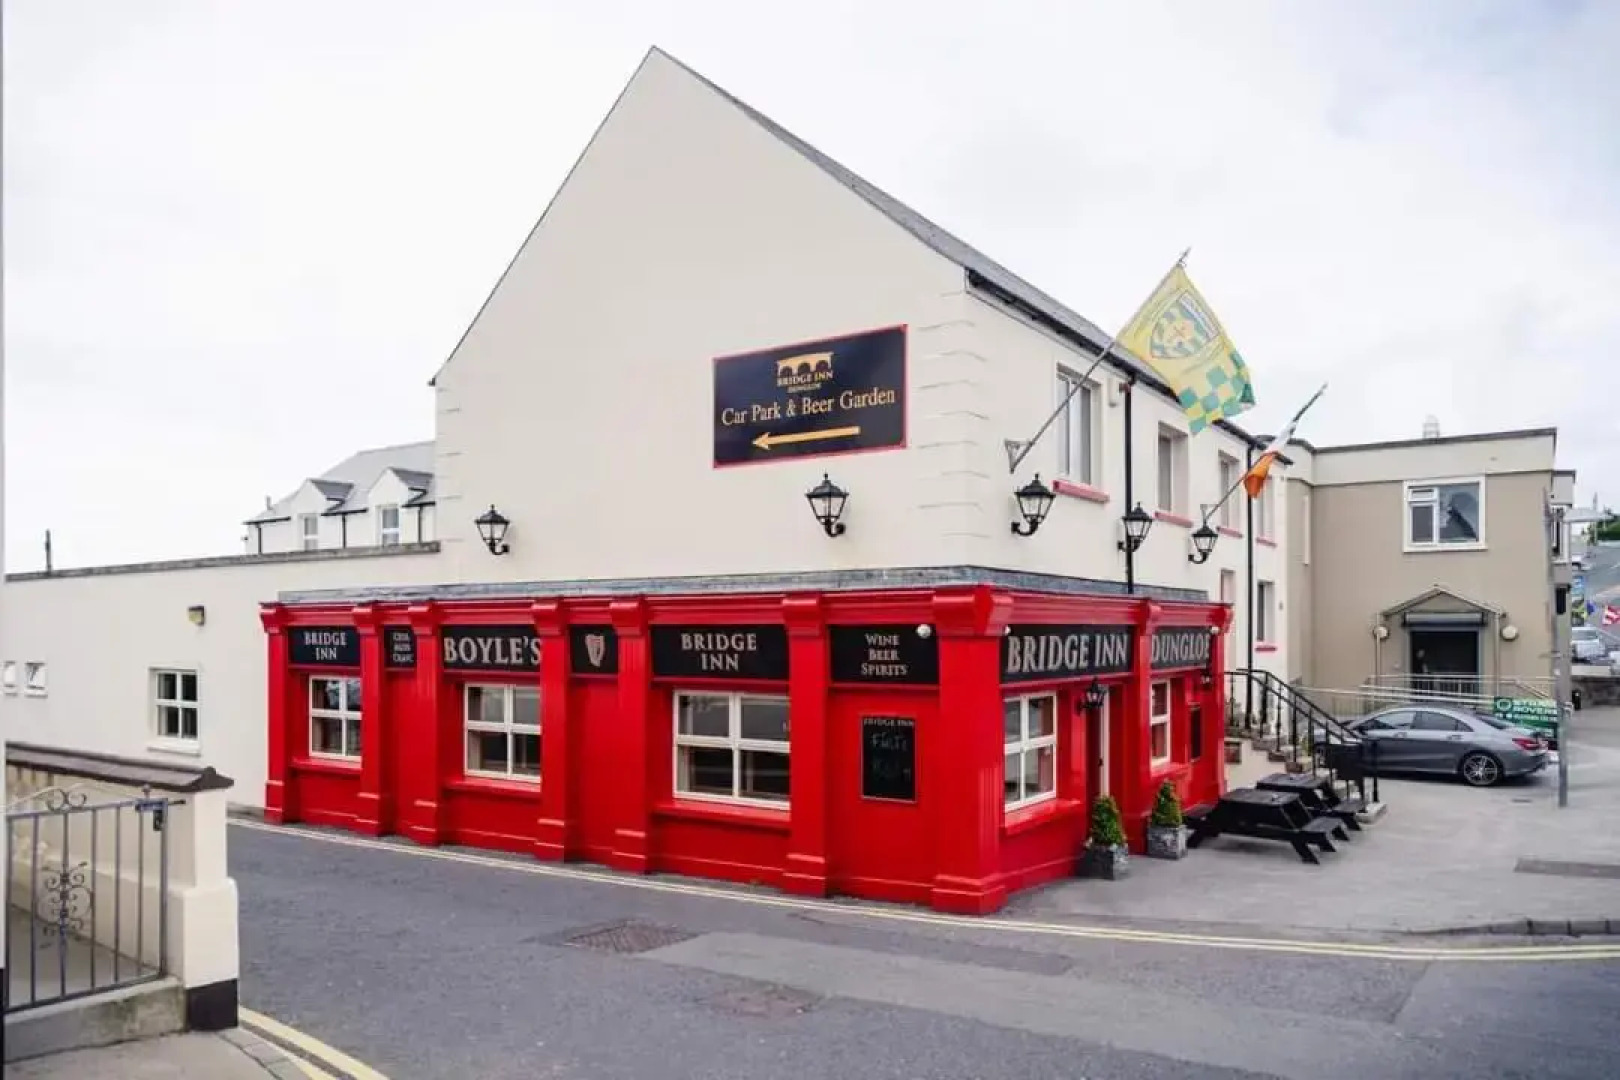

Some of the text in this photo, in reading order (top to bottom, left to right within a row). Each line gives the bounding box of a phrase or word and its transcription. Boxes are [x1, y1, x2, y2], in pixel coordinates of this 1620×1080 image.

[814, 371, 834, 382] INN
[721, 408, 747, 426] Car
[752, 402, 781, 422] Park
[785, 399, 796, 417] &
[802, 397, 834, 415] Beer
[839, 387, 895, 410] Garden
[303, 631, 347, 646] BRIDGE
[681, 632, 757, 652] BRIDGE
[865, 634, 899, 647] WINE
[315, 647, 337, 661] INN
[443, 635, 542, 665] BOYLE'S
[868, 648, 899, 661] BEER
[1006, 633, 1128, 673] BRIDGE INN
[701, 653, 739, 671] INN
[860, 662, 908, 677] SPIRITS
